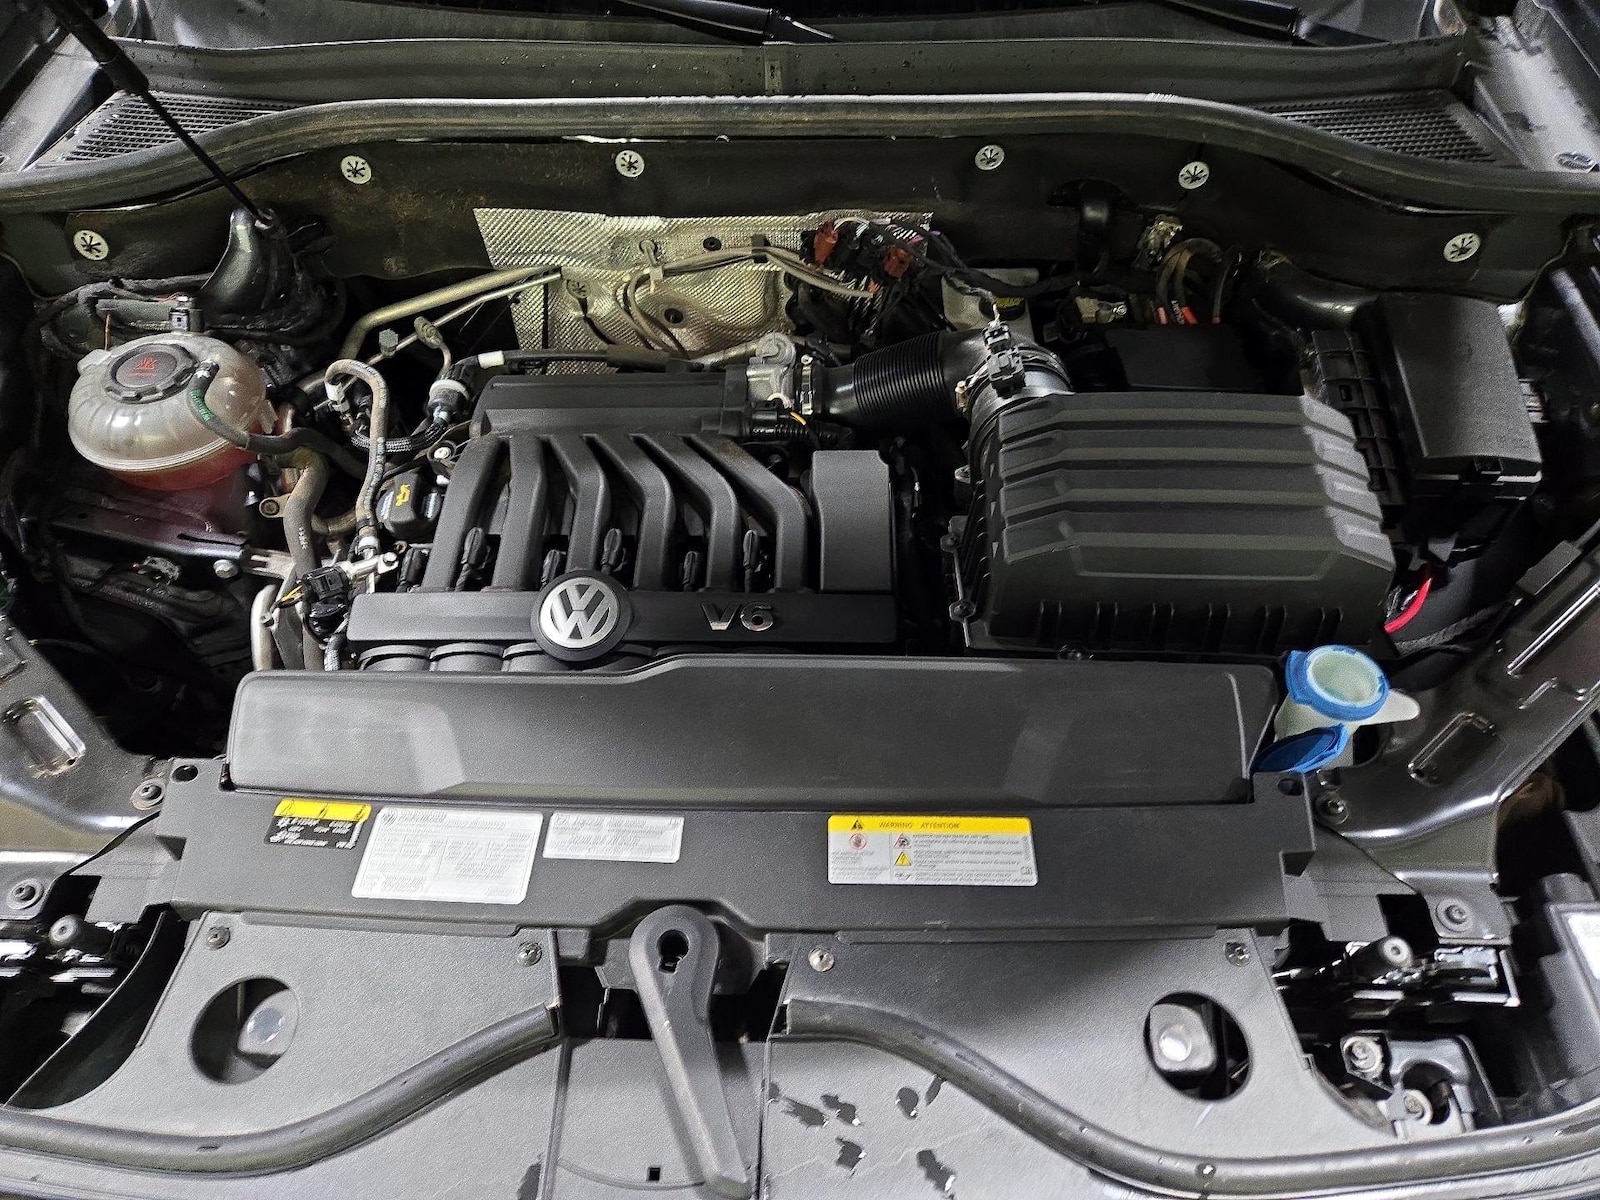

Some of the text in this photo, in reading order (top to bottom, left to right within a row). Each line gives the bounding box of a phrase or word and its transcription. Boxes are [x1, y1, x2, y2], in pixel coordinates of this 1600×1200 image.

[702, 601, 775, 632] V6
[878, 821, 960, 830] WARNING ATTENTION
